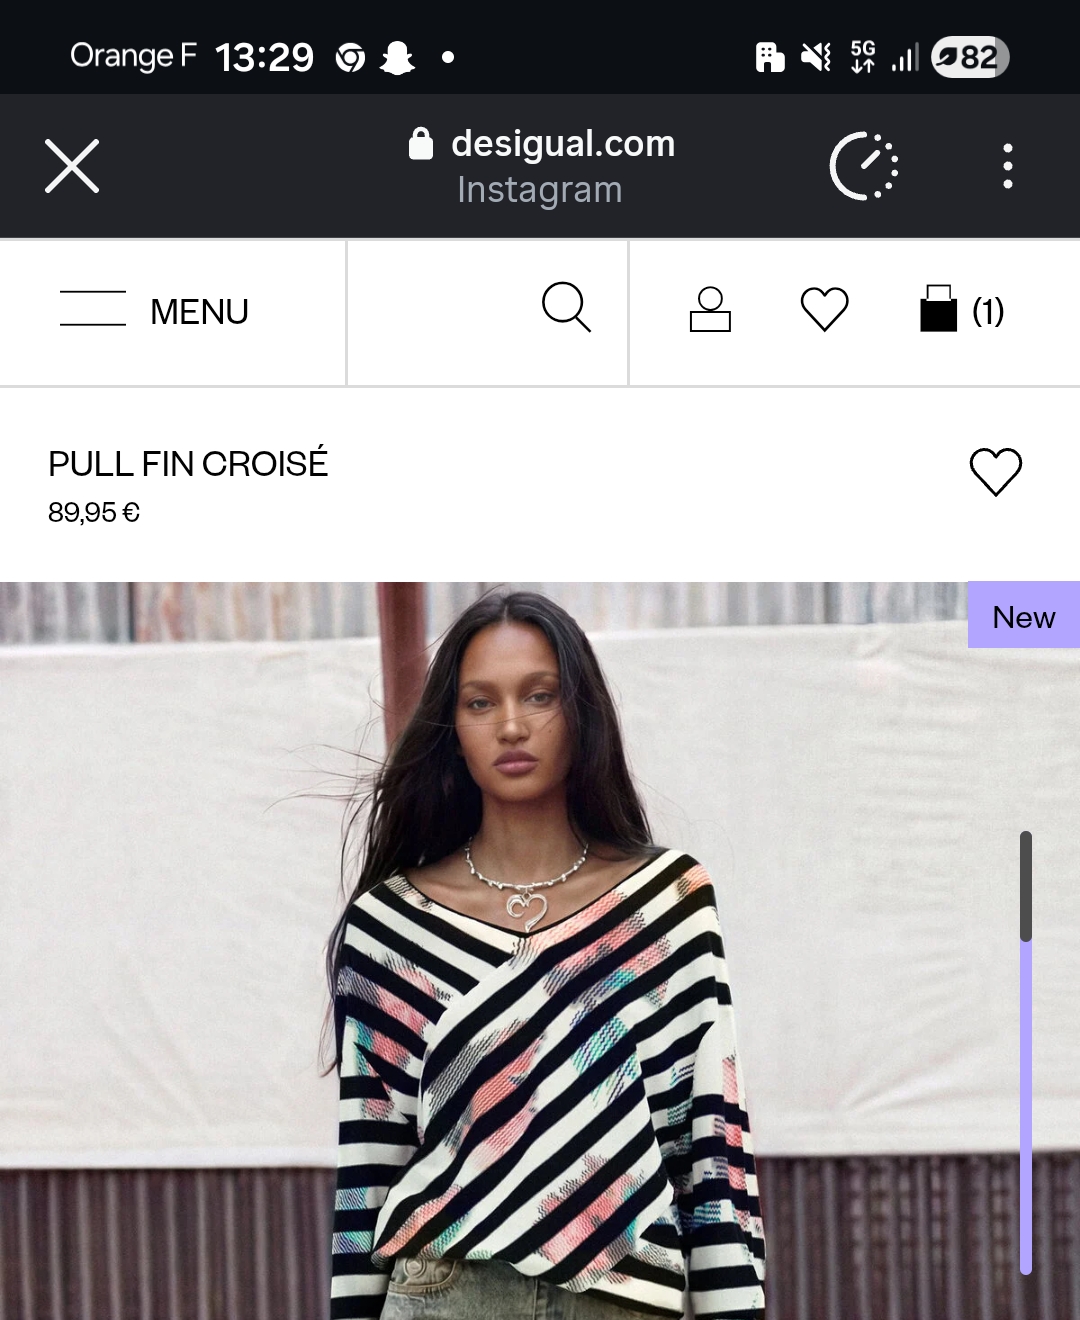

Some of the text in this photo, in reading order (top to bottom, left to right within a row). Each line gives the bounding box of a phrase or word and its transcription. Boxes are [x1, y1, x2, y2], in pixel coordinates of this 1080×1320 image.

[70, 41, 198, 75] Orange F
[214, 41, 314, 73] 13:29
[850, 39, 876, 56] 5G
[960, 44, 998, 70] 82
[451, 128, 675, 165] desigual.com
[459, 175, 622, 211] Instagram
[151, 298, 248, 325] MENU
[972, 296, 1005, 328] (1)
[49, 443, 329, 477] PULL FIN CROISÉ
[48, 501, 140, 527] 89,95 €
[993, 605, 1057, 629] New
